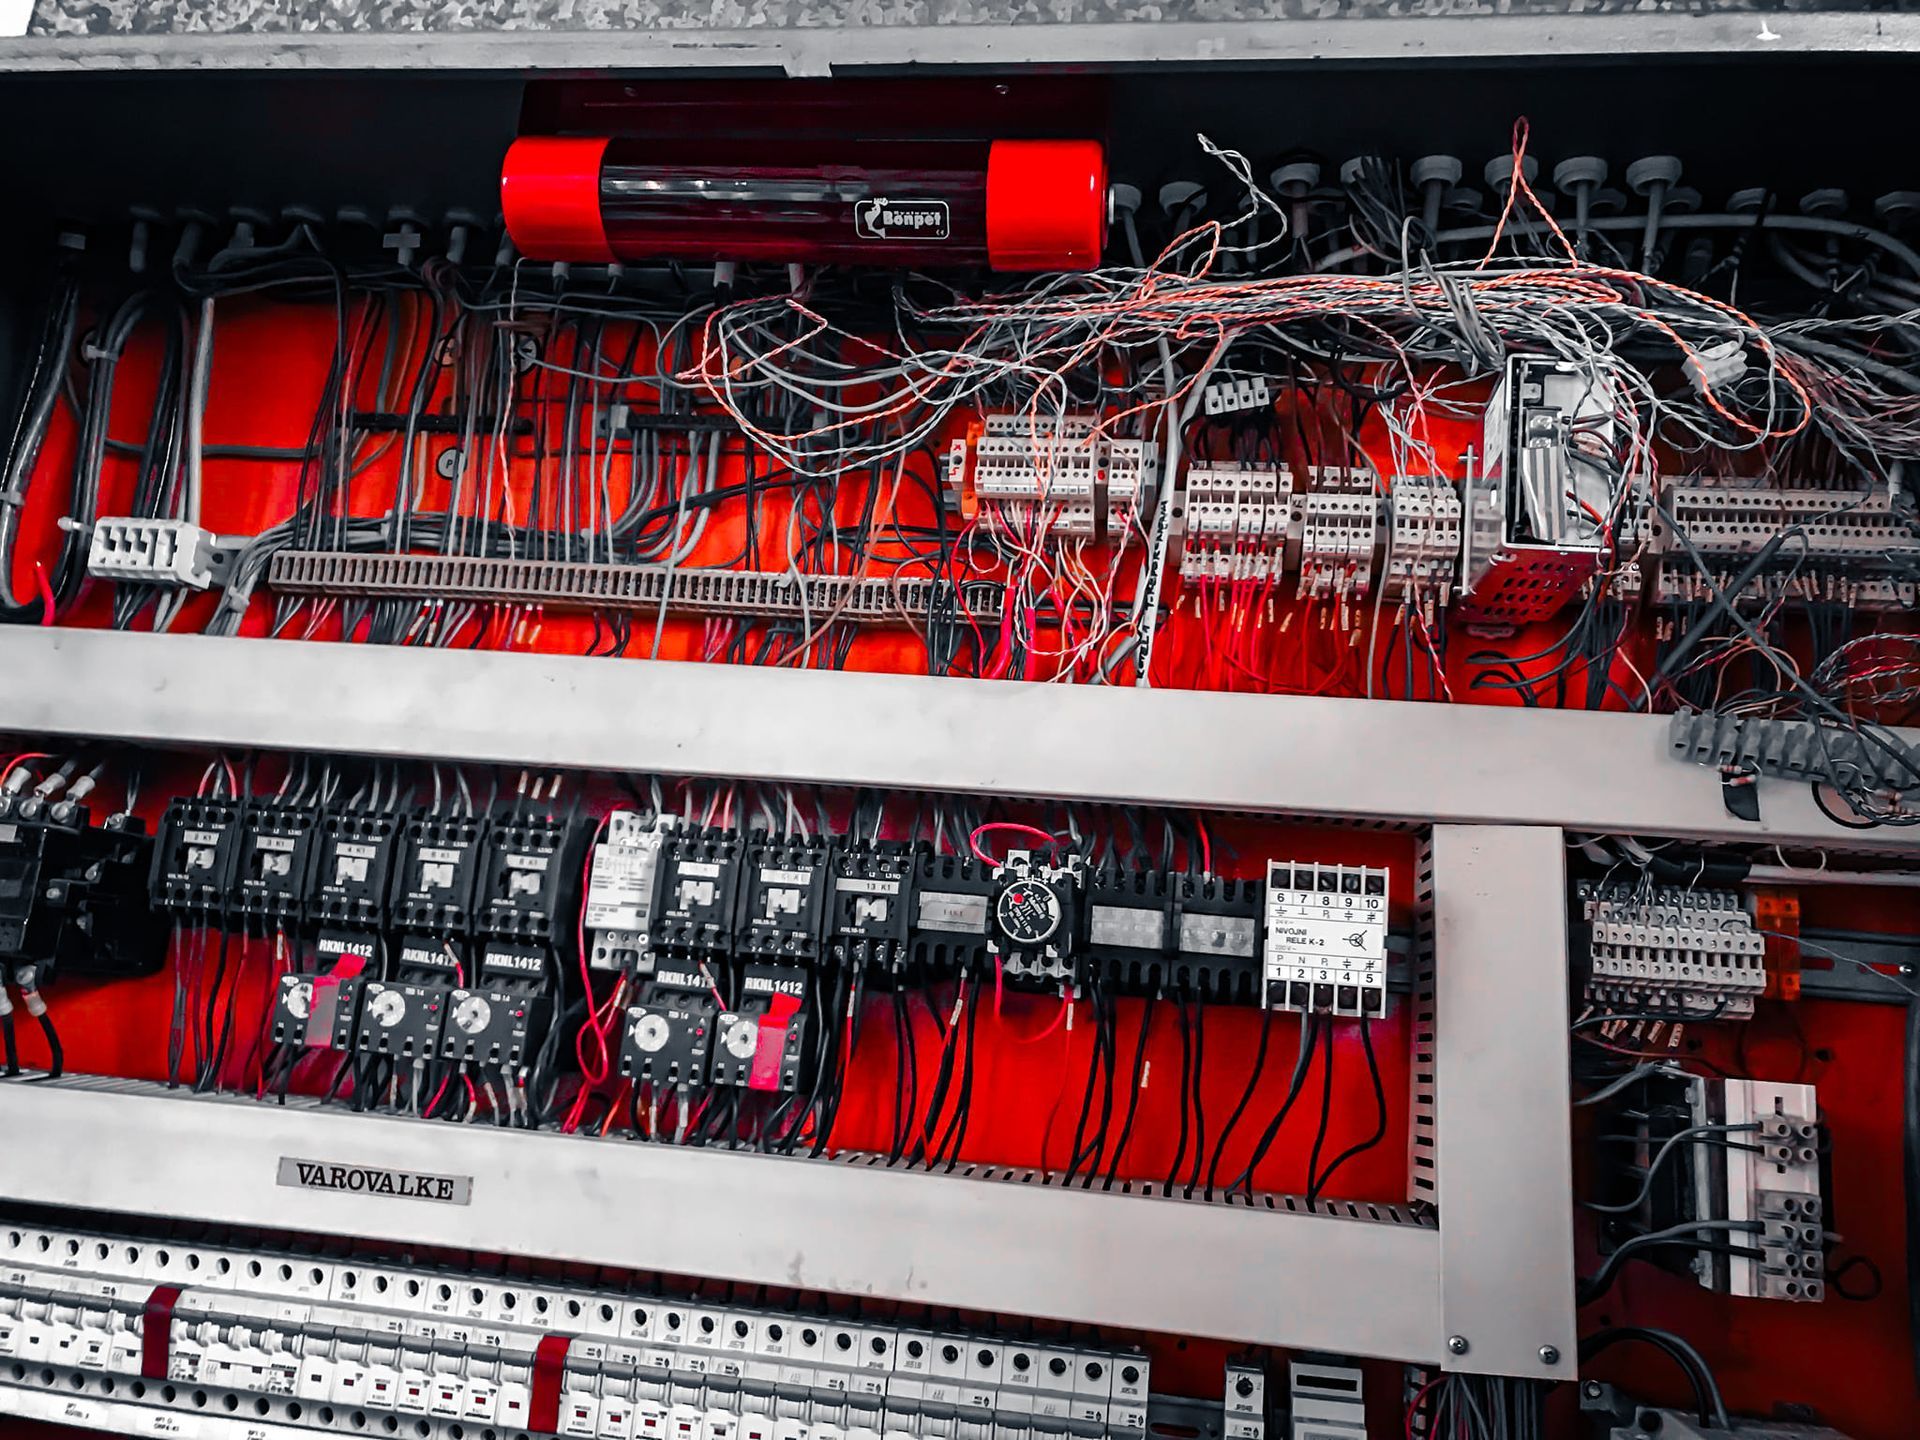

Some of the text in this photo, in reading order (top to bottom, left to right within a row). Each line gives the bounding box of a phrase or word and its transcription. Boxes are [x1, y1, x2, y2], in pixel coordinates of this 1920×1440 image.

[883, 210, 941, 229] Bonpet
[1277, 892, 1378, 909] 6 7 8 9 10
[1286, 936, 1325, 946] RELE K-2
[1297, 969, 1305, 978] 2
[1320, 970, 1327, 980] 3
[1343, 972, 1350, 981] 4
[1366, 974, 1373, 983] 5
[296, 1162, 455, 1201] VAROVALKE
